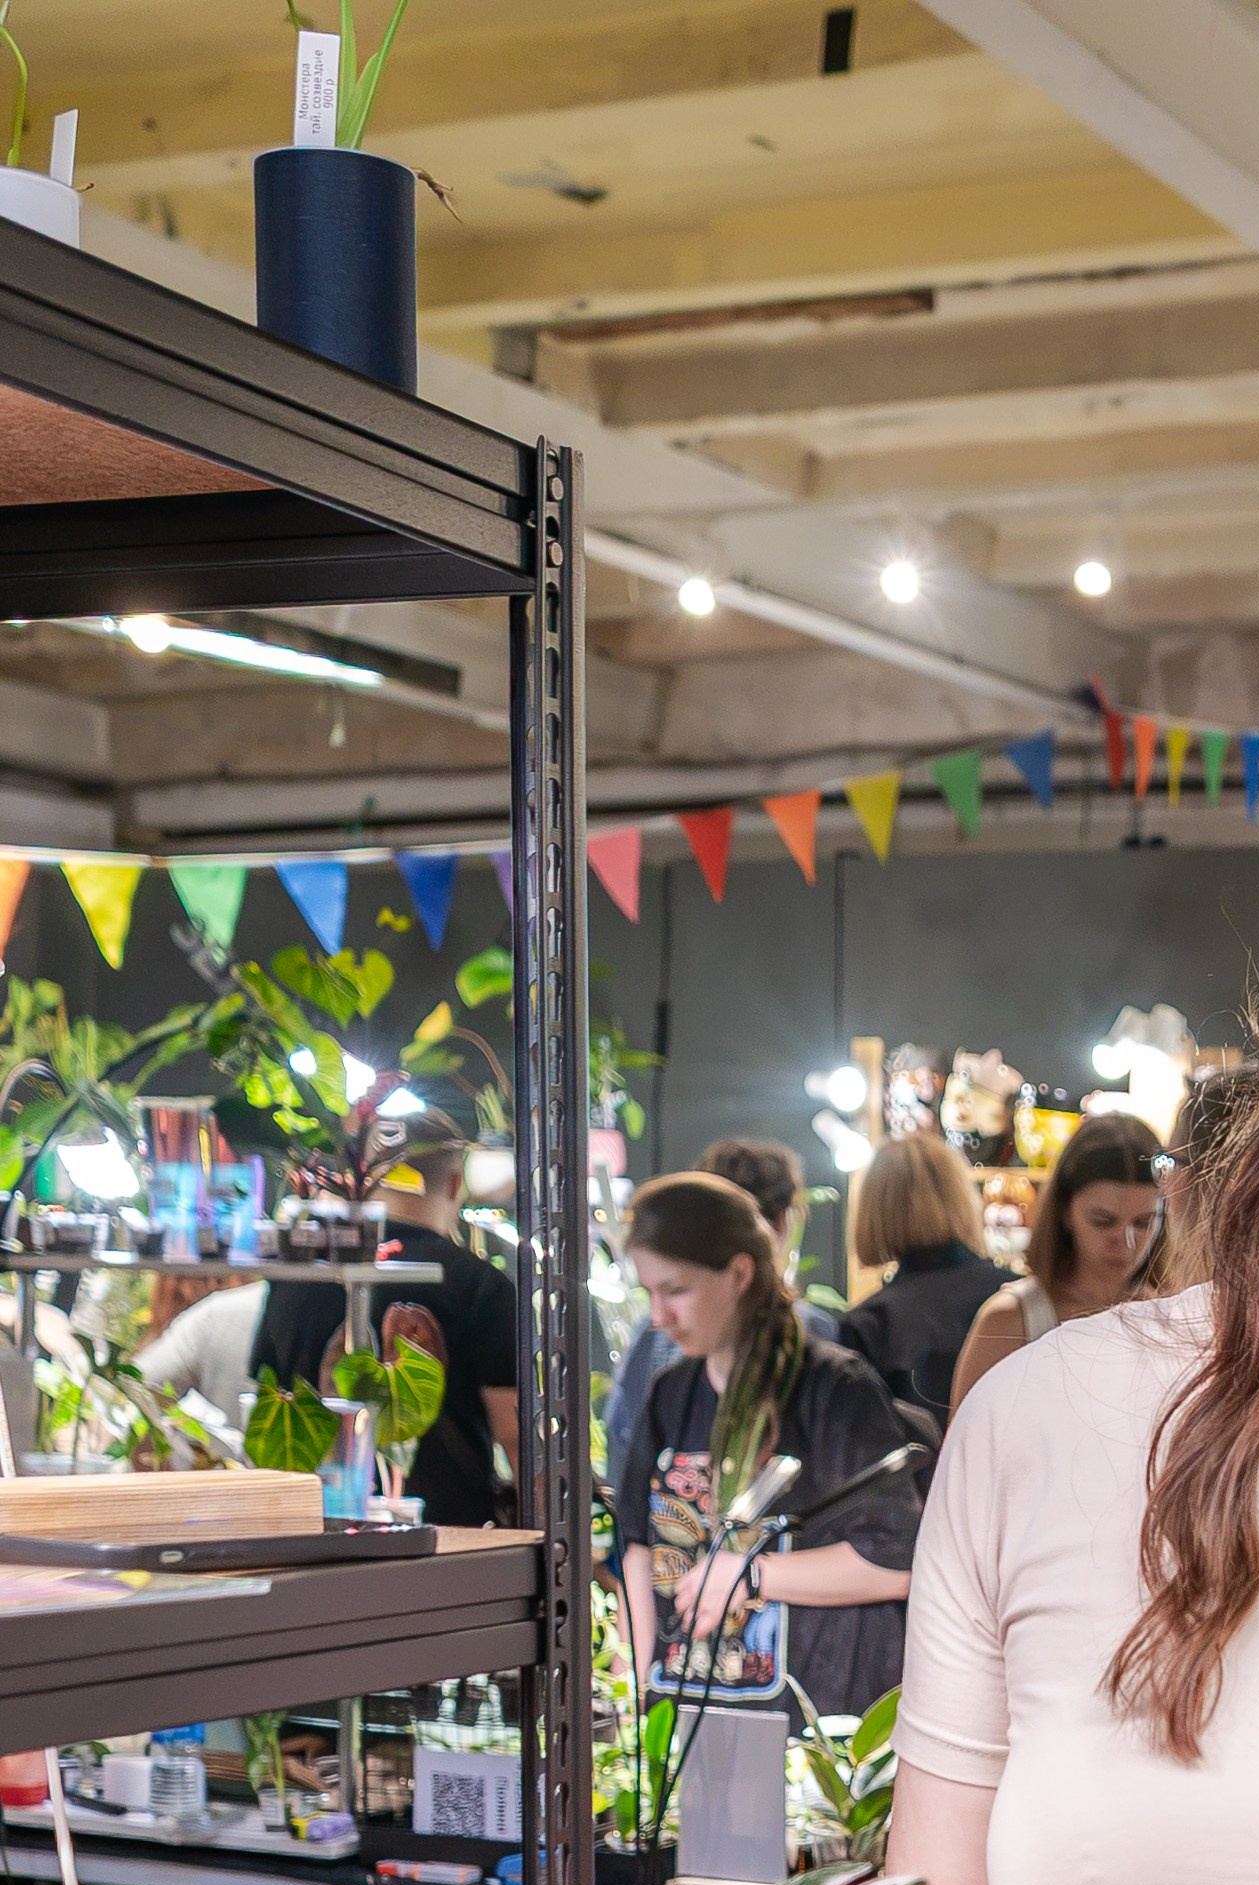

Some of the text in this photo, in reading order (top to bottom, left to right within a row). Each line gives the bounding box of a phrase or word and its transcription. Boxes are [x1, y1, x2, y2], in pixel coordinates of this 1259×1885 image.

[299, 63, 312, 119] Монстера
[312, 49, 324, 109] созвездие
[323, 88, 335, 109] 900
